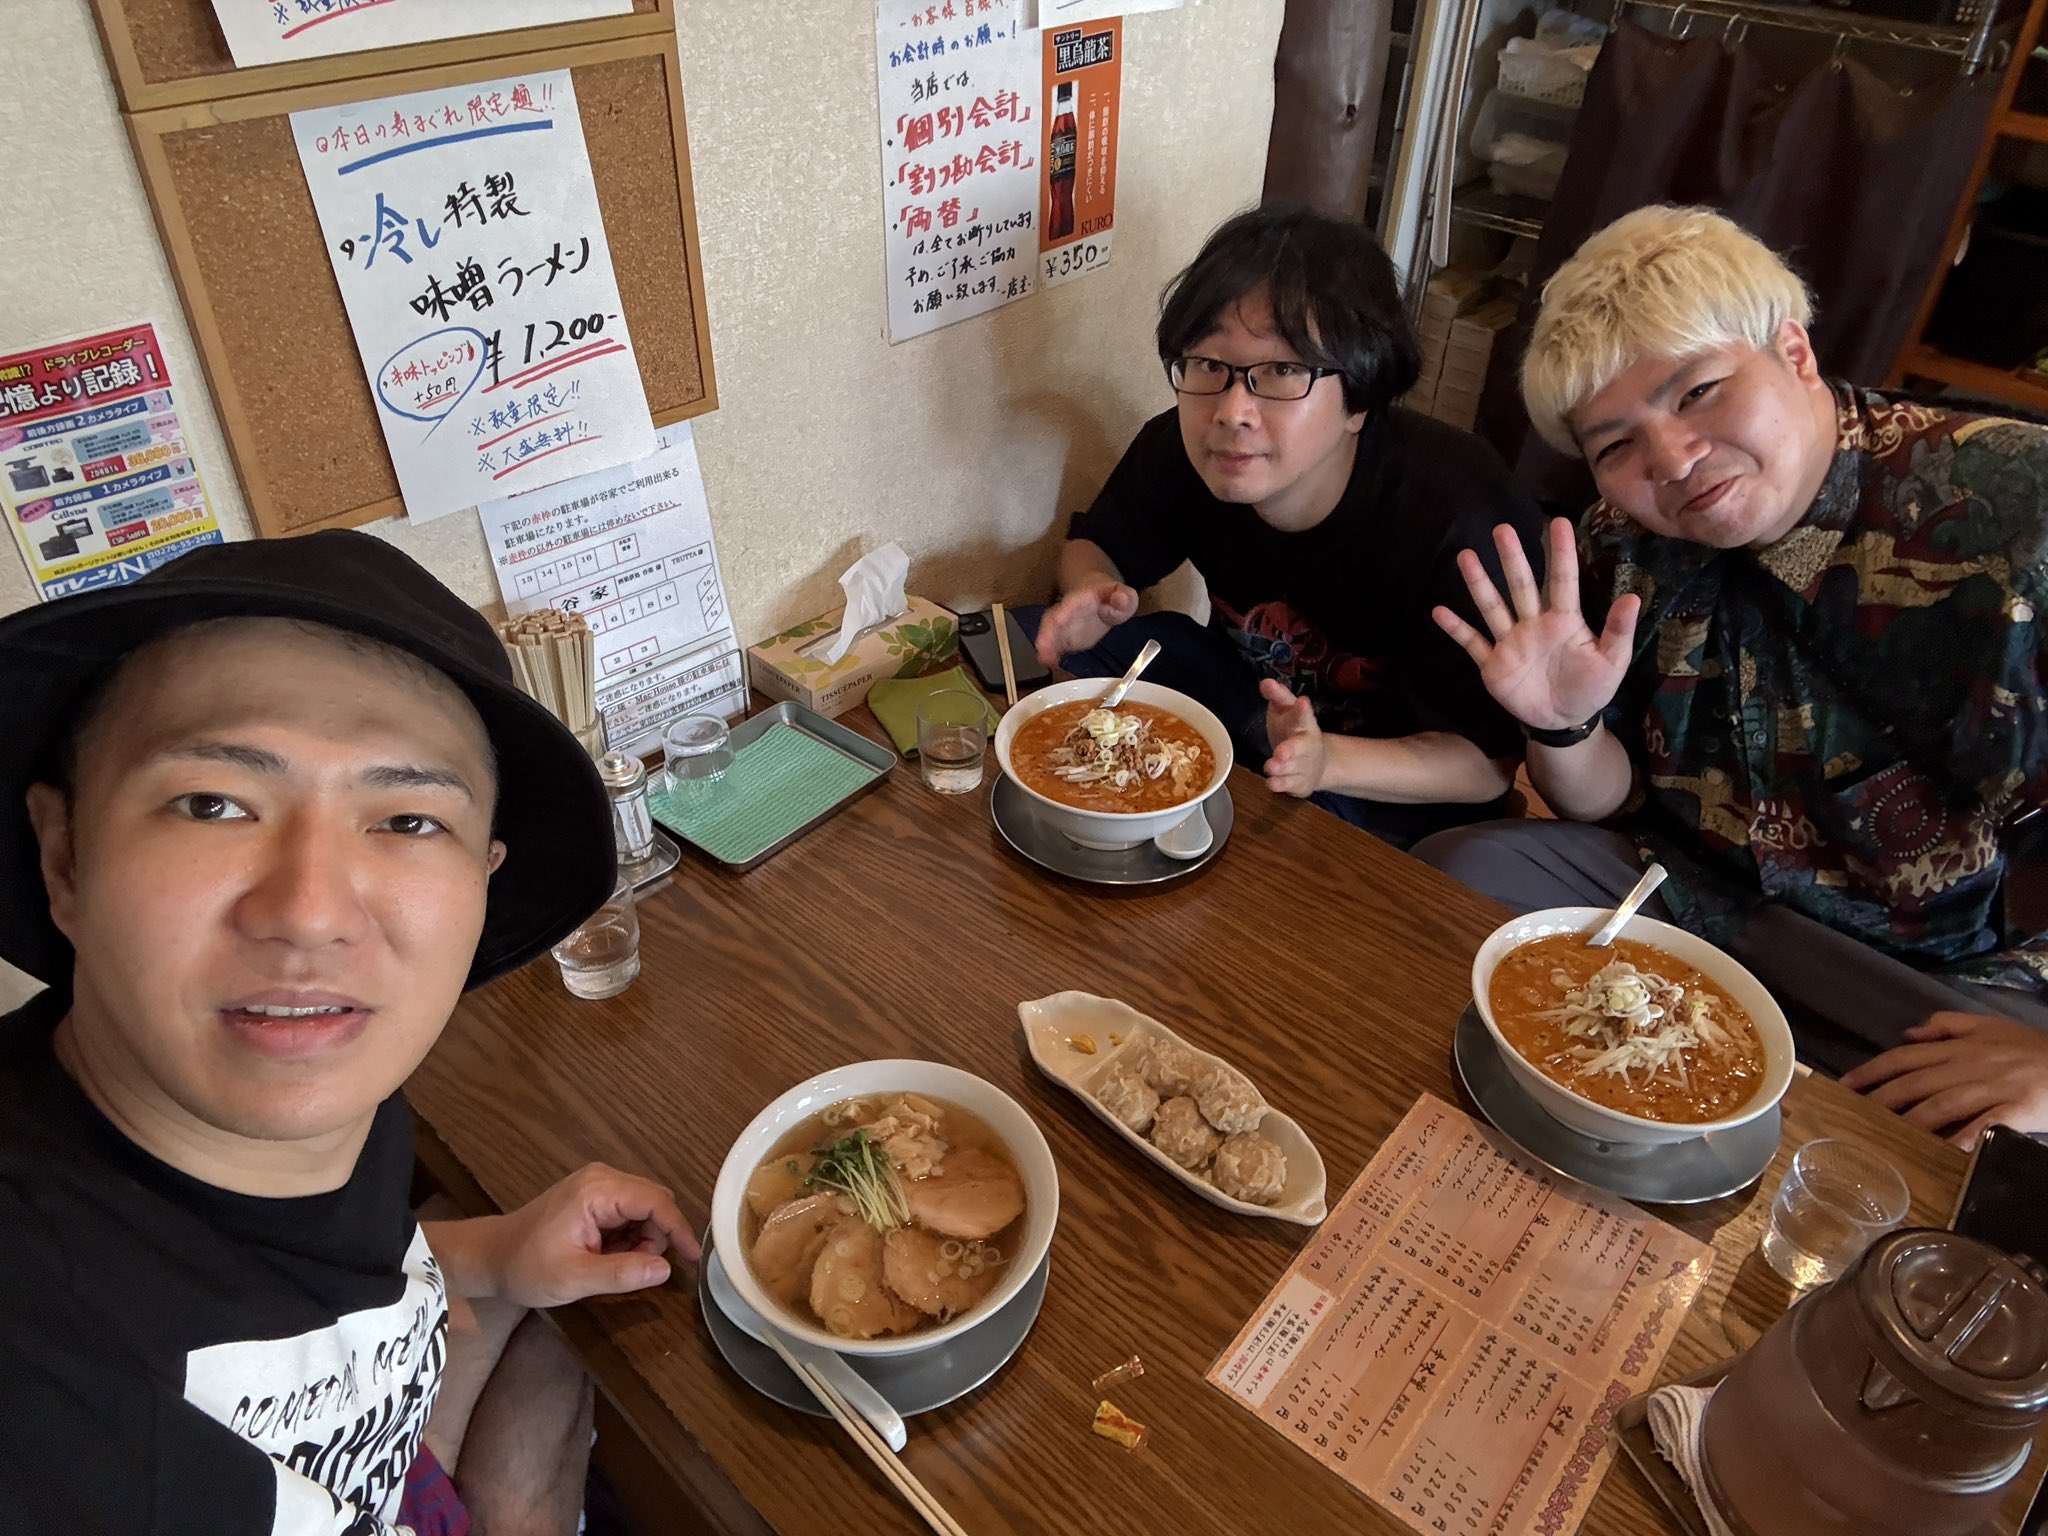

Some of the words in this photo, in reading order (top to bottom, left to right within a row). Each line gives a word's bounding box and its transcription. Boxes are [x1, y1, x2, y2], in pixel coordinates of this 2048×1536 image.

[1058, 37, 1109, 70] 黒烏龍茶
[1082, 214, 1113, 235] KURO
[409, 237, 591, 323] 味噌ラーメン
[43, 339, 145, 371] ドライブレコーダー
[502, 467, 680, 532] 下記の赤枠の駐車場が谷家でご利用出来る
[504, 517, 589, 549] 駐車場になります。
[521, 575, 534, 584] 13
[541, 568, 554, 578] 14
[561, 561, 574, 571] 15
[581, 553, 593, 563] 16
[671, 550, 698, 566] TRUTTA
[610, 616, 619, 625] 6
[629, 607, 637, 616] 7
[646, 600, 655, 609] 8
[664, 594, 672, 603] 9
[613, 656, 622, 665] 2
[640, 645, 649, 654] 3
[1418, 1113, 1445, 1148] トッピング
[1326, 1267, 1388, 1351] 辛味噌ネギチャーシュー
[1355, 1278, 1407, 1348] 辛味噌チャーシュー
[1375, 1290, 1426, 1358] 辛味噌ネギラーメン
[1404, 1302, 1444, 1355] 辛味噌ラーメン
[1407, 1344, 1446, 1392] 辛味噌
[1445, 1335, 1497, 1417] 味噌ネギチャーシュー
[1475, 1348, 1517, 1414] 味噌チャーシュー
[1496, 1360, 1537, 1424] 味噌ネギラーメン
[1526, 1373, 1558, 1420] 味噌ラーメン
[1547, 1401, 1574, 1436] 味噌
